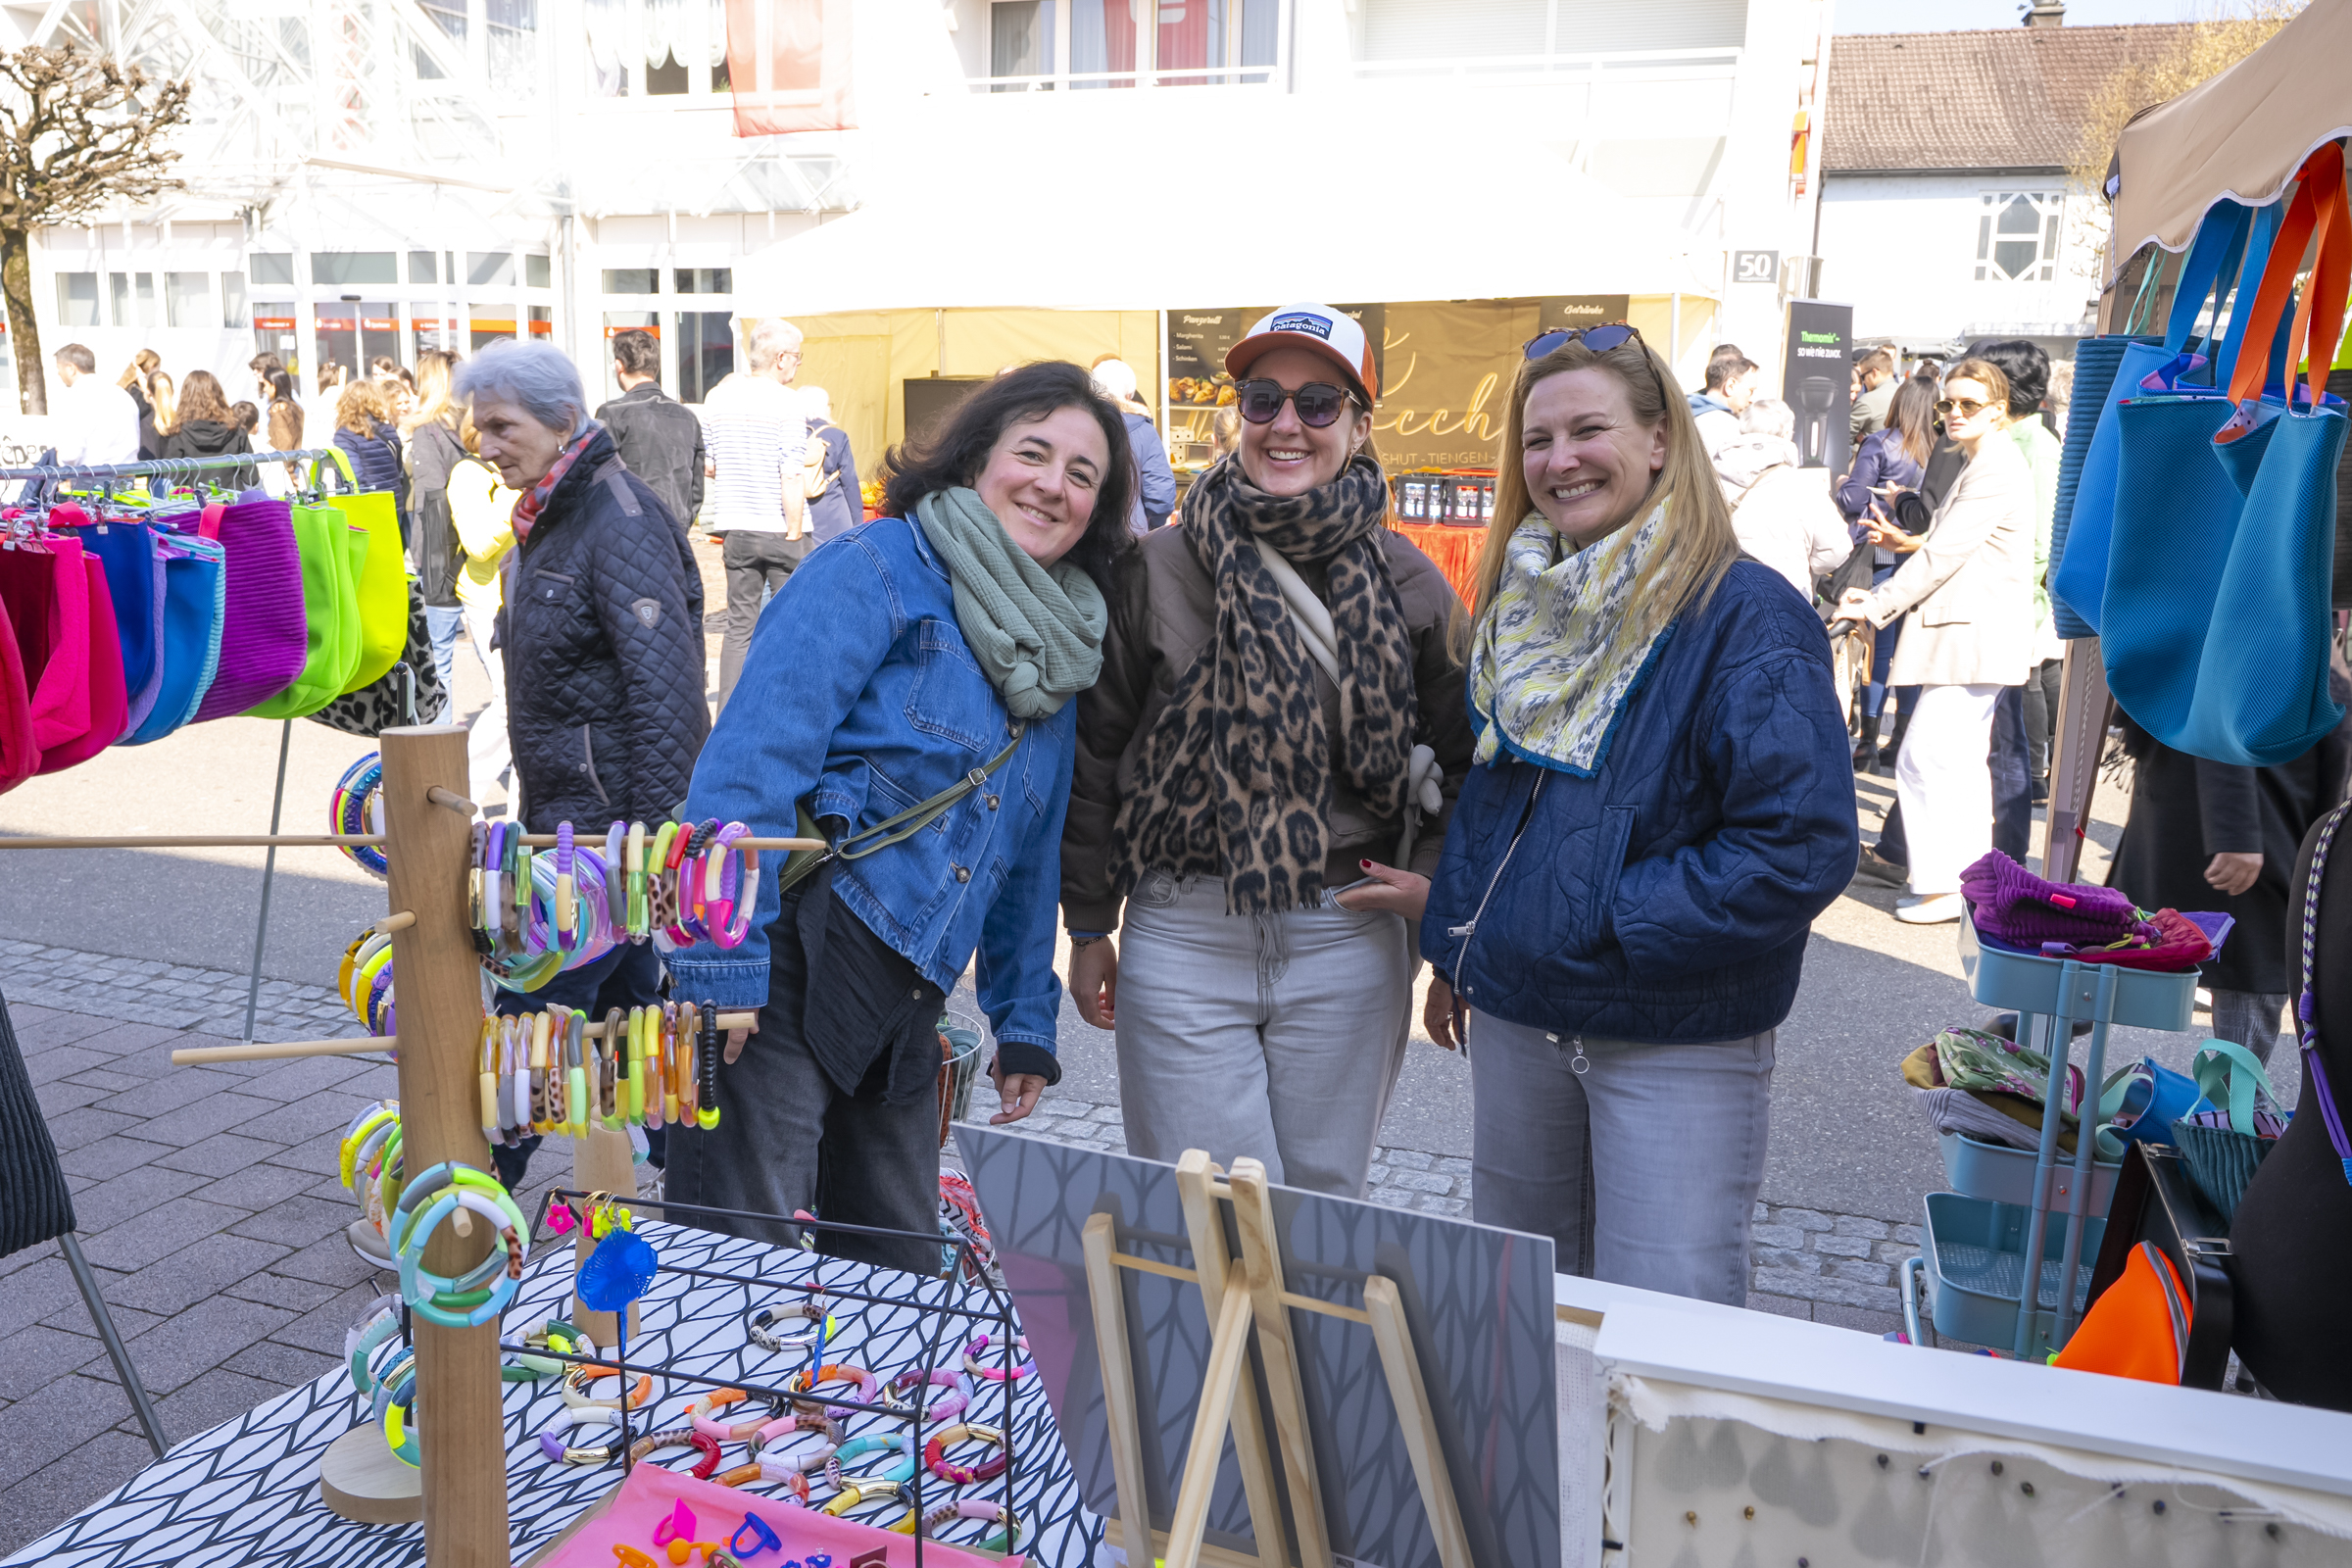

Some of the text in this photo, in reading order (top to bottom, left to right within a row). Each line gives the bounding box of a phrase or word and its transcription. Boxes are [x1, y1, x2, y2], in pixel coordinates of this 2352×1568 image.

[1739, 254, 1772, 277] 50
[1274, 320, 1327, 336] patagonia
[1427, 452, 1489, 466] TIENGEN
